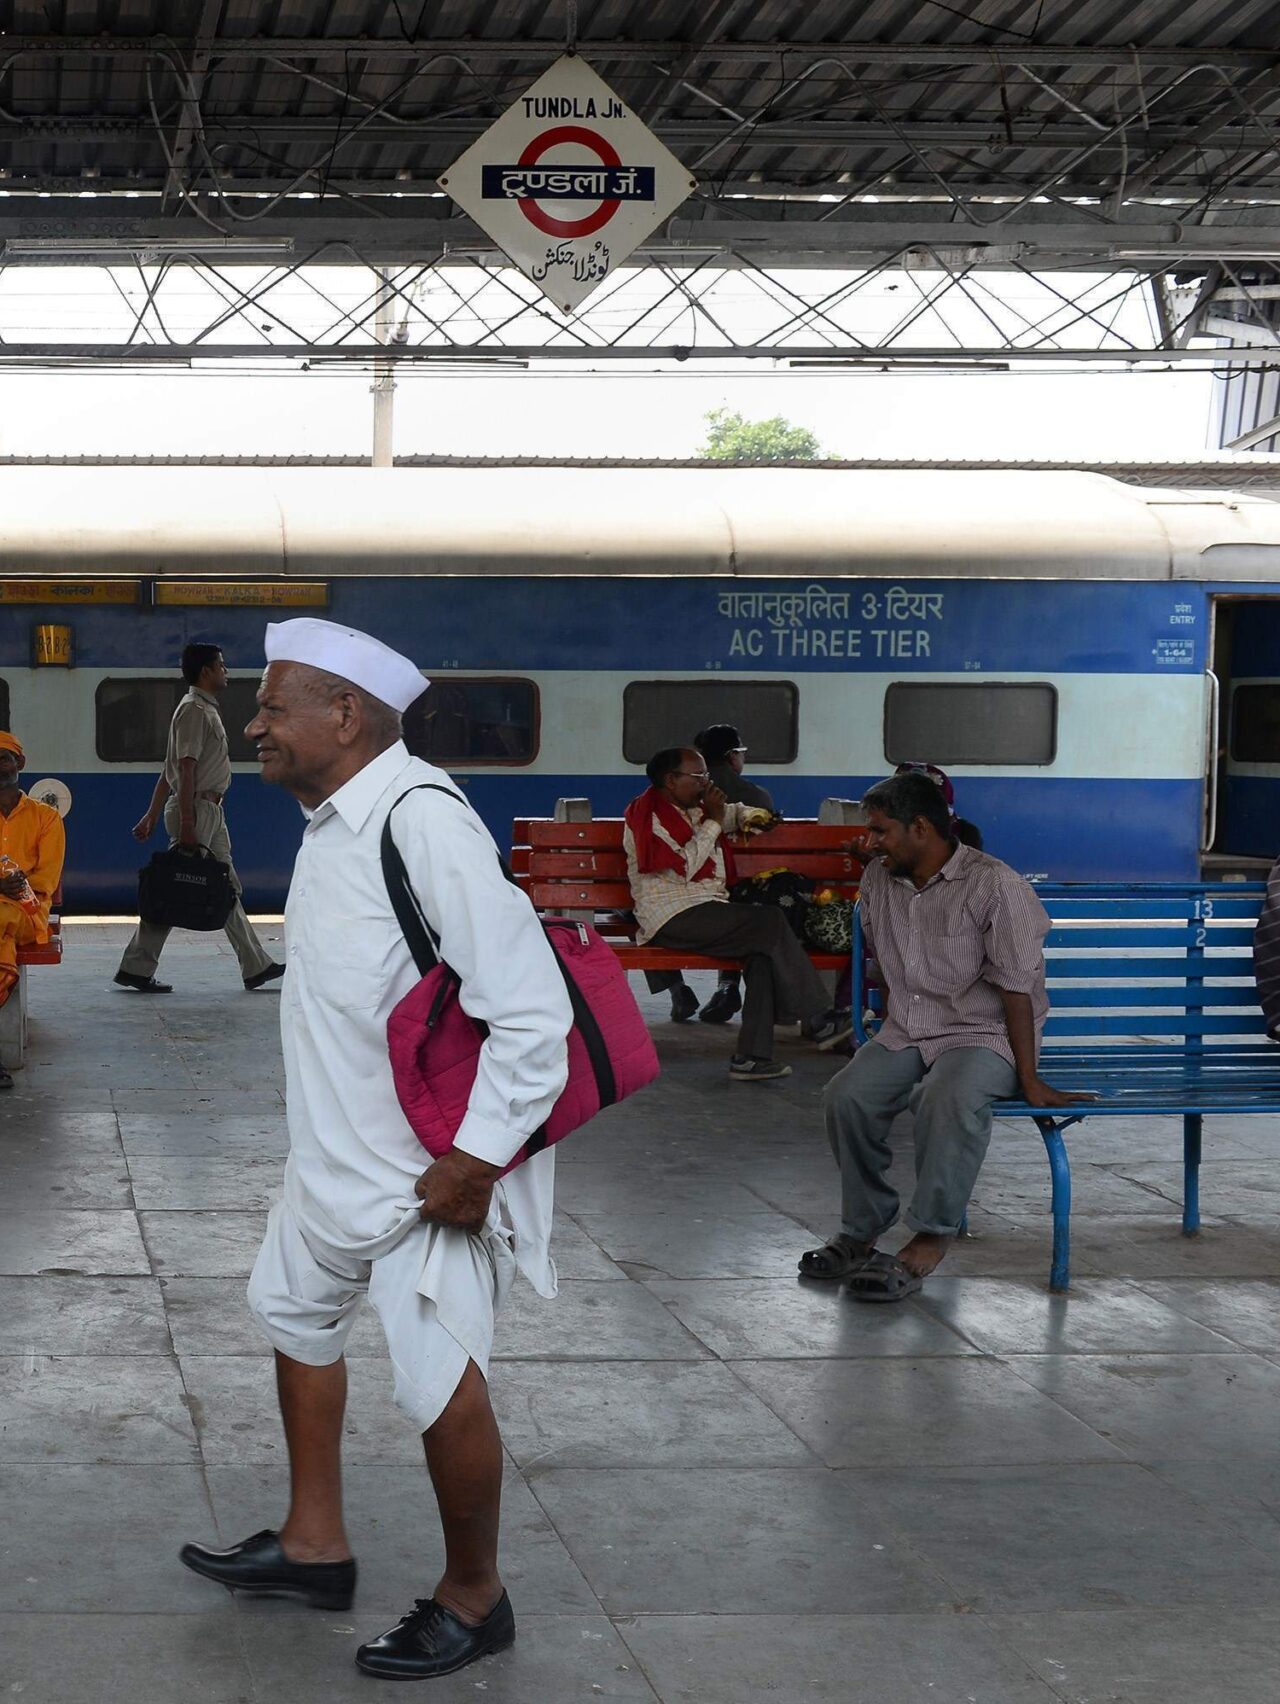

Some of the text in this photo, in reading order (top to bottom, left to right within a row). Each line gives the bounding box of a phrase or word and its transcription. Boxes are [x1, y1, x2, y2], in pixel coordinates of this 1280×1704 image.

[522, 97, 597, 119] TUNDLA
[501, 171, 608, 198] टूण्डला
[718, 584, 851, 627] वातानुकूलित
[1169, 616, 1196, 625] ENTRY
[729, 629, 931, 657] AC THREE TIER
[843, 858, 853, 872] 3
[1194, 900, 1213, 919] 13
[1196, 928, 1207, 947] 2
